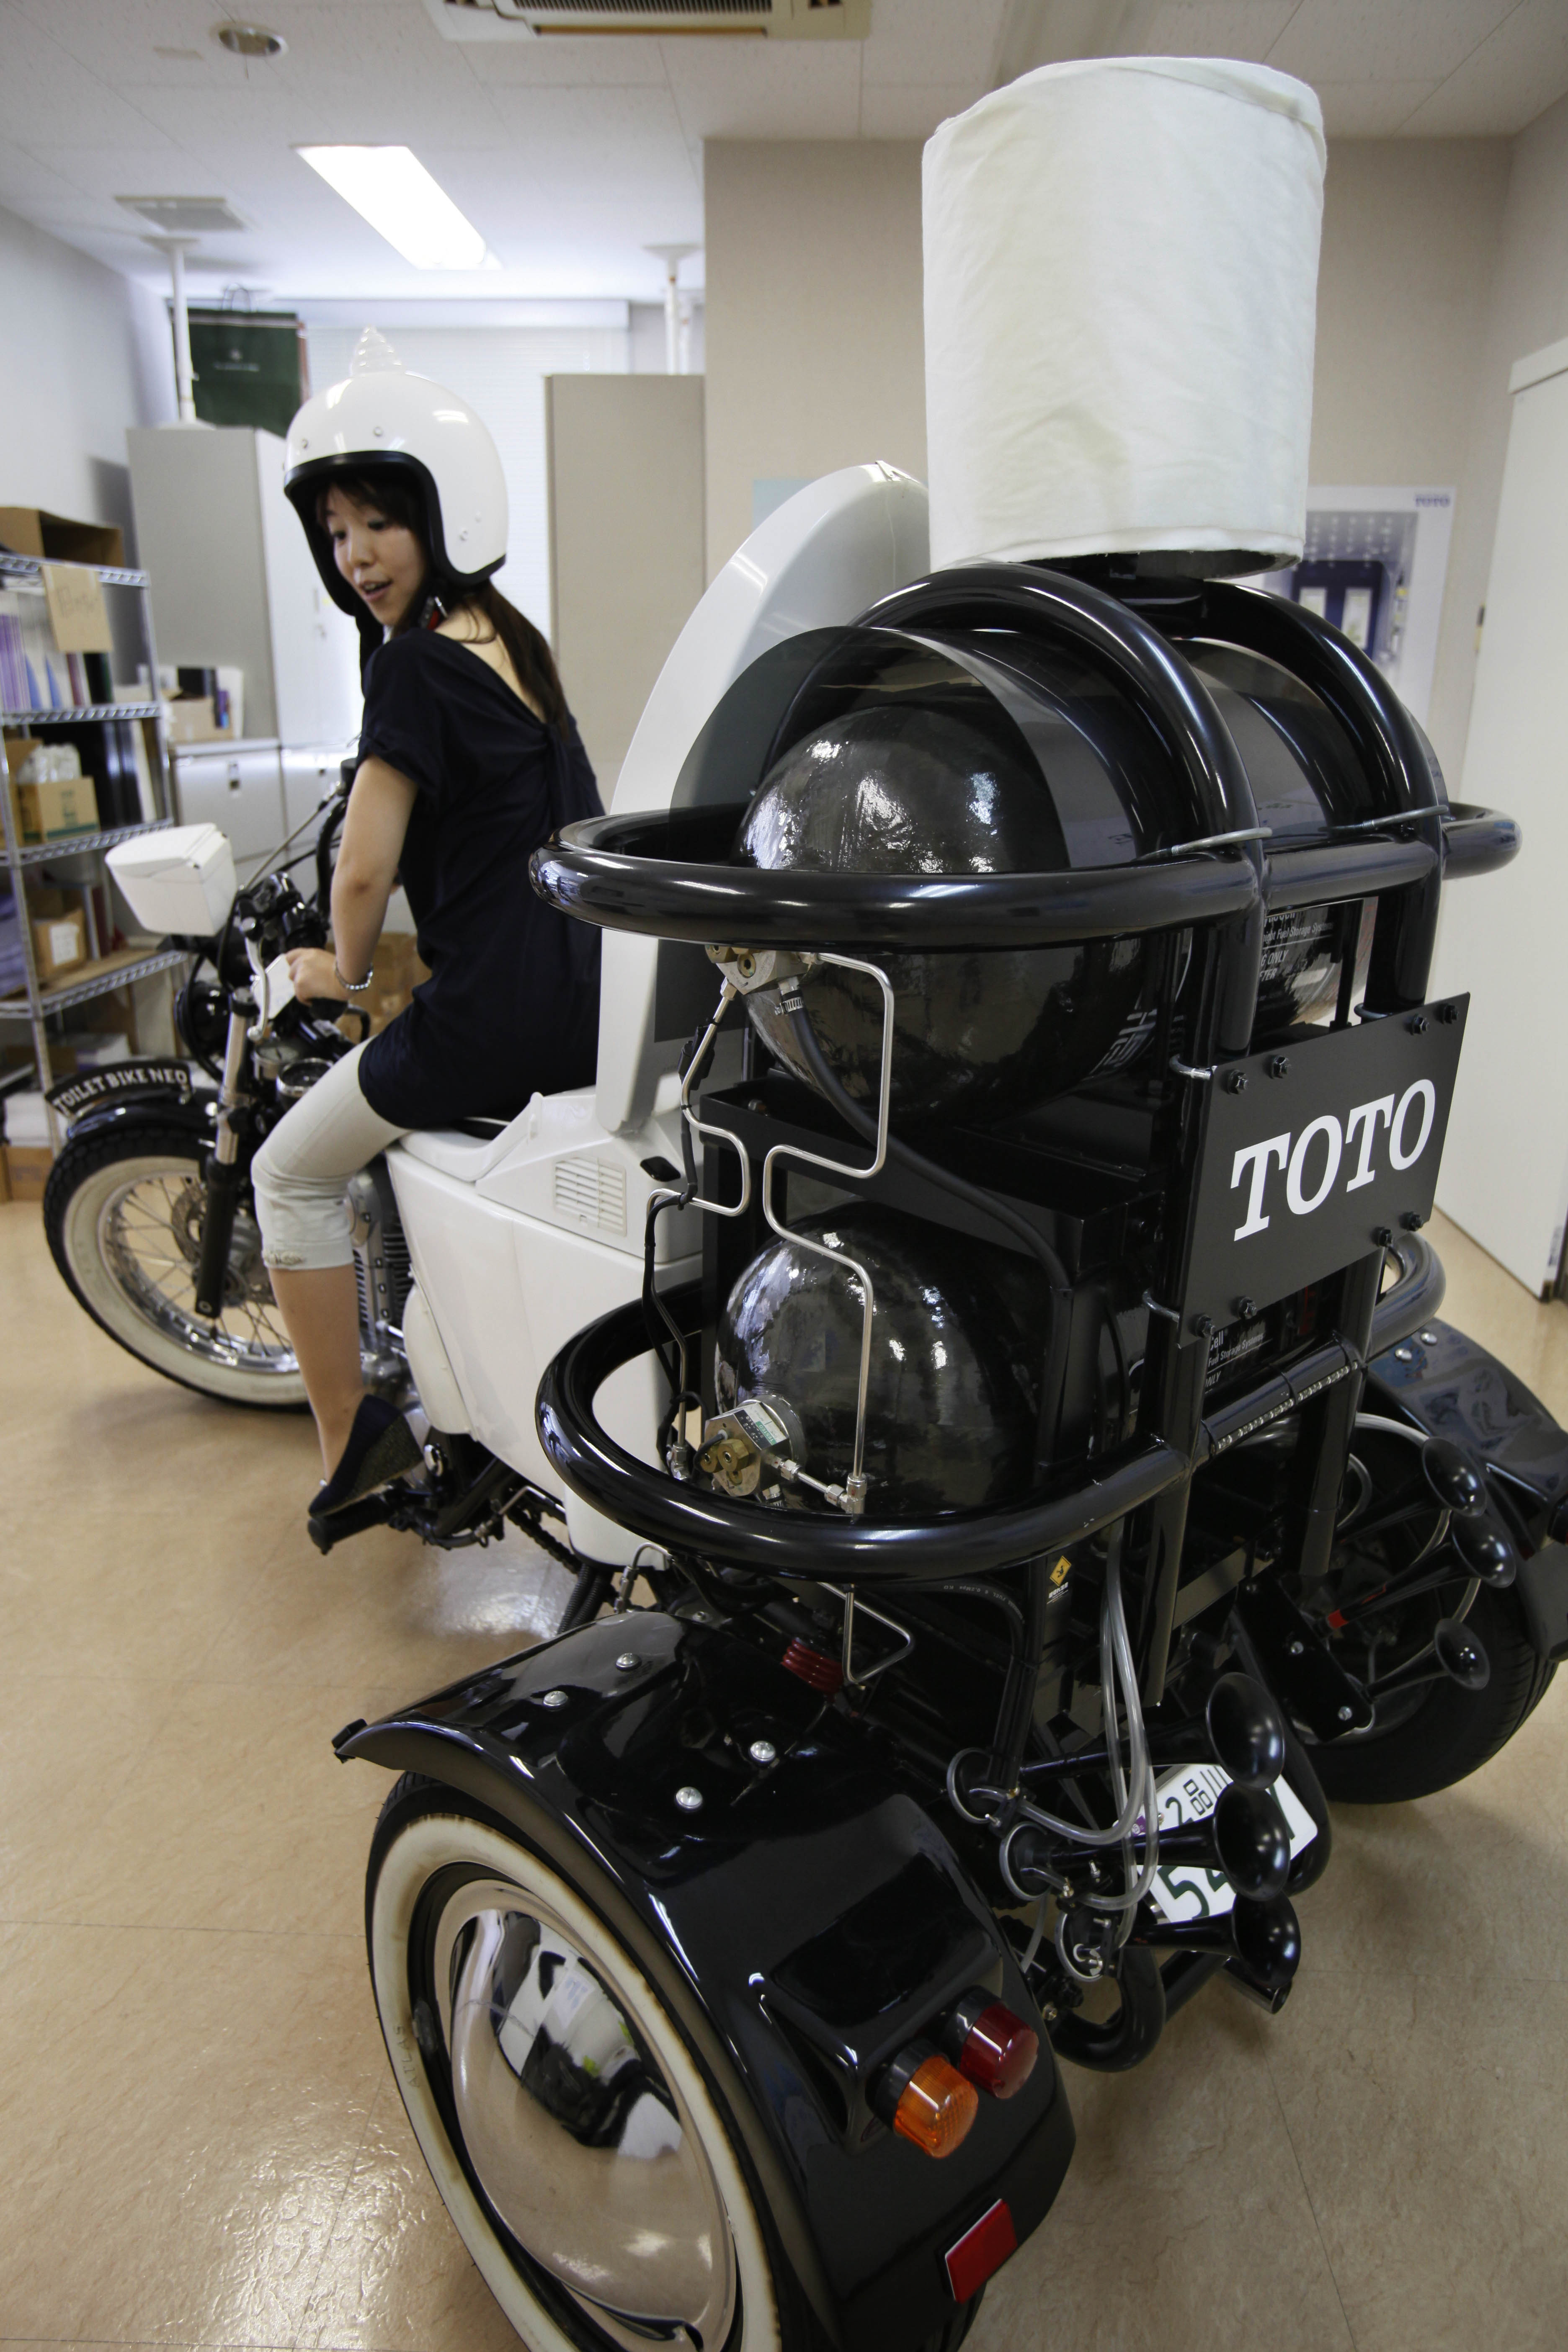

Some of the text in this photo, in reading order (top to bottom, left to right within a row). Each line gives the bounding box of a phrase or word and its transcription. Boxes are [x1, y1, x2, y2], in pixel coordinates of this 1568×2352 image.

[1277, 928, 1289, 939] Fuel
[1290, 925, 1311, 937] Storage
[1267, 949, 1289, 965] ONLY
[52, 1076, 106, 1117] TOILET
[104, 1068, 149, 1088] BIKE
[1230, 1079, 1436, 1241] TOTO
[1208, 1333, 1264, 1367] Fuel Storage Systems
